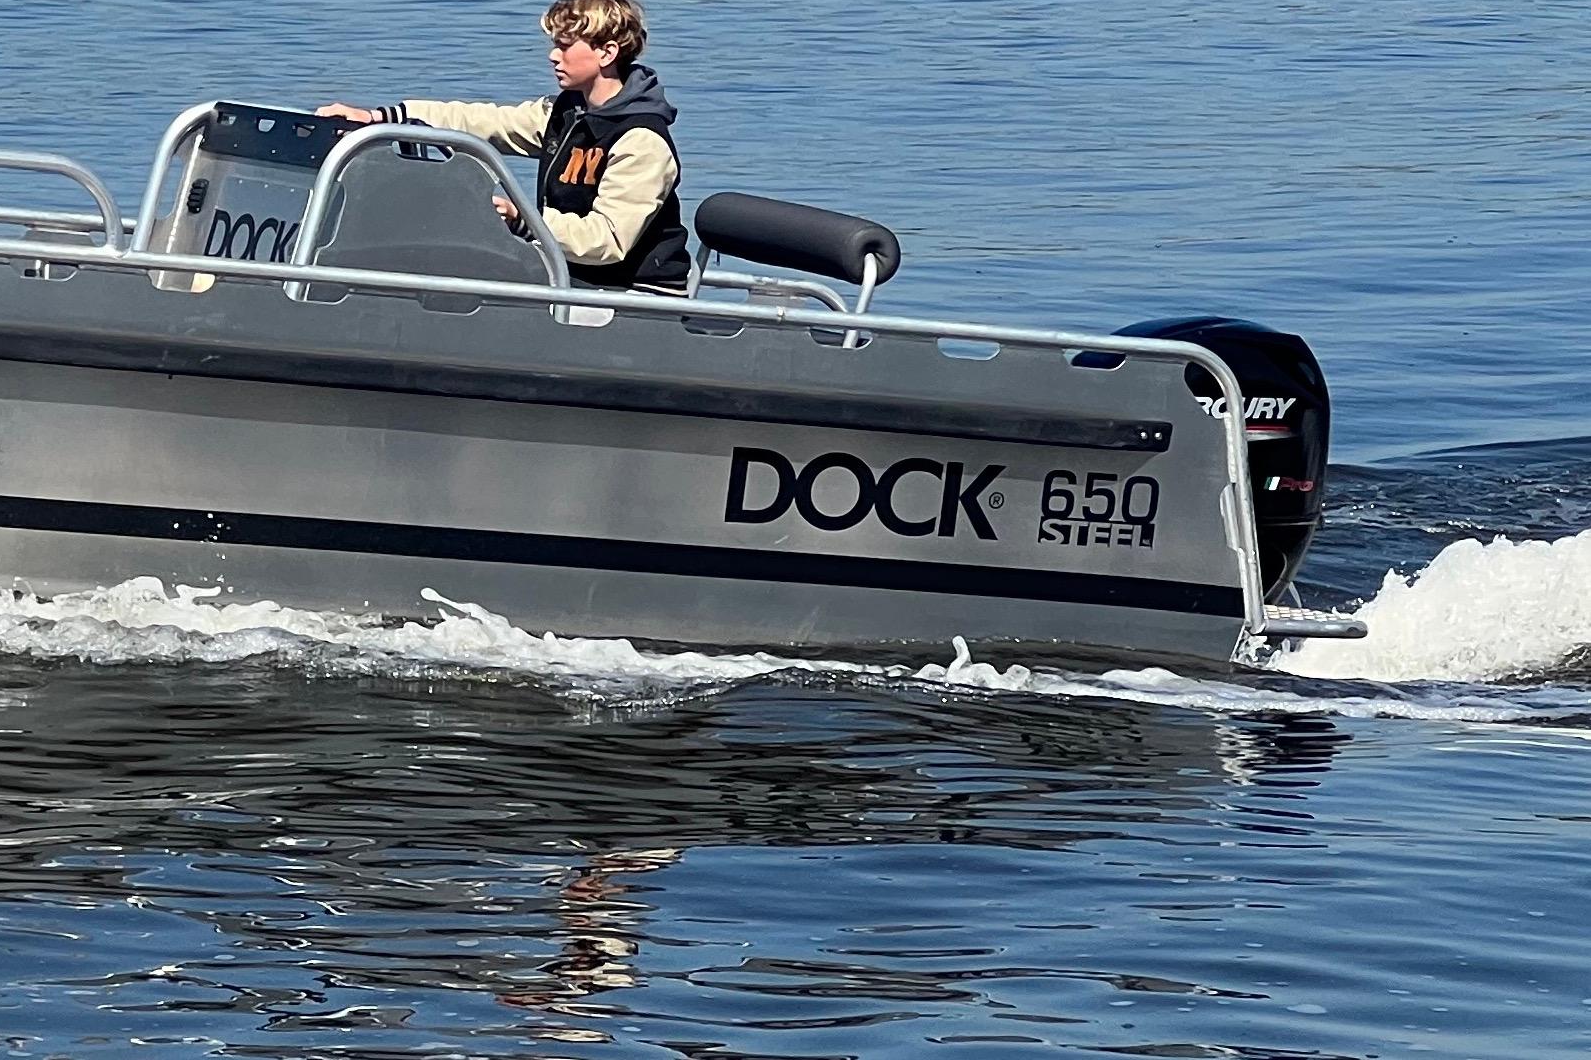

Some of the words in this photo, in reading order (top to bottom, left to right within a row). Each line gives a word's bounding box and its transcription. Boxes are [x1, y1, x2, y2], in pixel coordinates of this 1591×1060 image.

[559, 146, 604, 185] NY
[204, 207, 300, 263] DOCK
[1041, 469, 1160, 524] 650
[1037, 517, 1156, 549] STEEL
